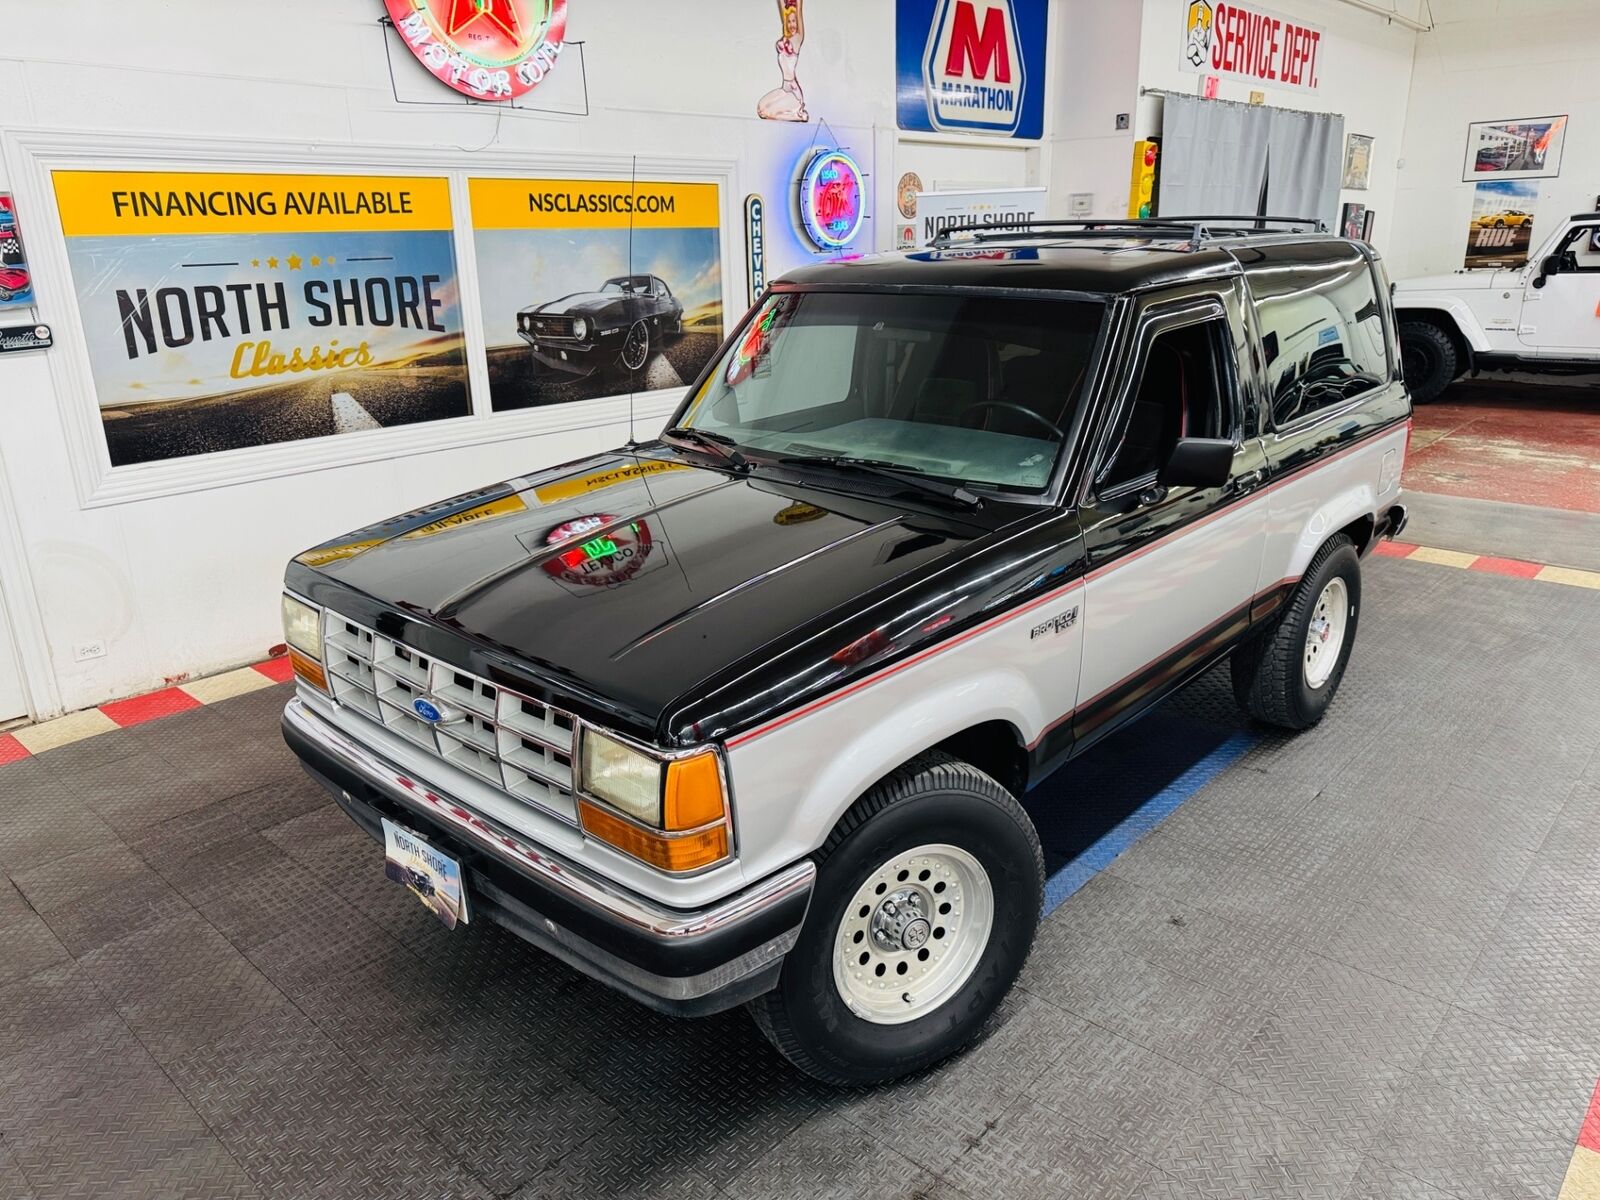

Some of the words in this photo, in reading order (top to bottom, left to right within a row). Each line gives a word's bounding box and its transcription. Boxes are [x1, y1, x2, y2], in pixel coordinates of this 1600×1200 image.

[400, 11, 512, 97] MOTOR
[515, 40, 564, 86] OIL
[1211, 3, 1281, 80] SERVICE
[1281, 24, 1321, 89] DEPT.
[941, 81, 1014, 112] MARATHON
[112, 191, 277, 217] FINANCING
[283, 191, 413, 215] AVAILABLE
[528, 193, 675, 213] NSCLASSICS.COM
[924, 213, 977, 241] NORTH
[982, 211, 1036, 233] SHORE
[1474, 228, 1518, 248] RIDE
[115, 281, 291, 360] NORTH
[303, 274, 447, 334] SHORE
[0, 330, 36, 346] orvette
[229, 339, 376, 380] Classics
[393, 830, 420, 859] NORTH
[421, 849, 448, 882] SHORE
